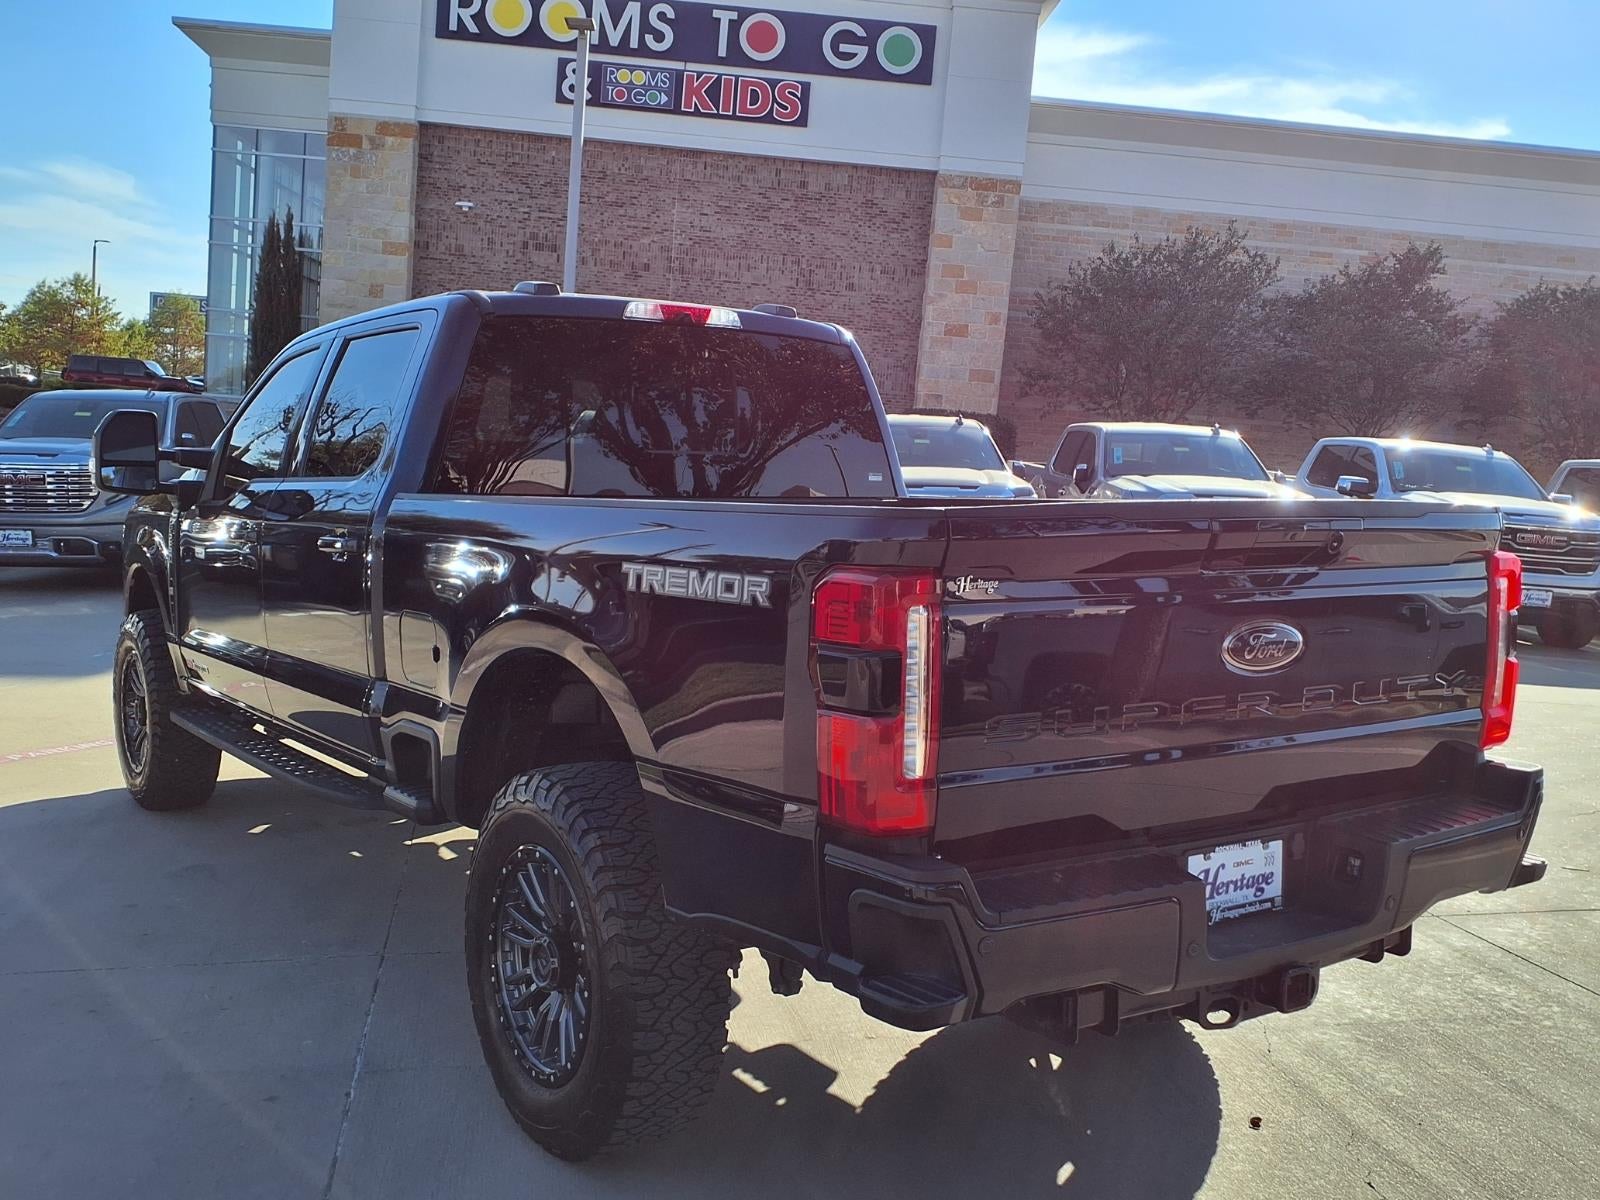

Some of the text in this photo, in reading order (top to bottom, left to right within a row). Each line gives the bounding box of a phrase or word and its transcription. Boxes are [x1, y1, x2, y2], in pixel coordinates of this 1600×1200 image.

[448, 0, 923, 76] ROOMS TO GO
[561, 61, 593, 101] &
[606, 67, 670, 88] ROOMS
[606, 86, 661, 105] TO GO
[680, 71, 803, 122] KIDS
[1516, 533, 1568, 546] GMC
[621, 561, 772, 608] TREMOR
[955, 575, 999, 595] Heritage
[1244, 633, 1288, 660] Ford
[984, 670, 1467, 743] SUPER DUTY
[1232, 858, 1254, 869] GMC
[1197, 862, 1274, 901] Heritage
